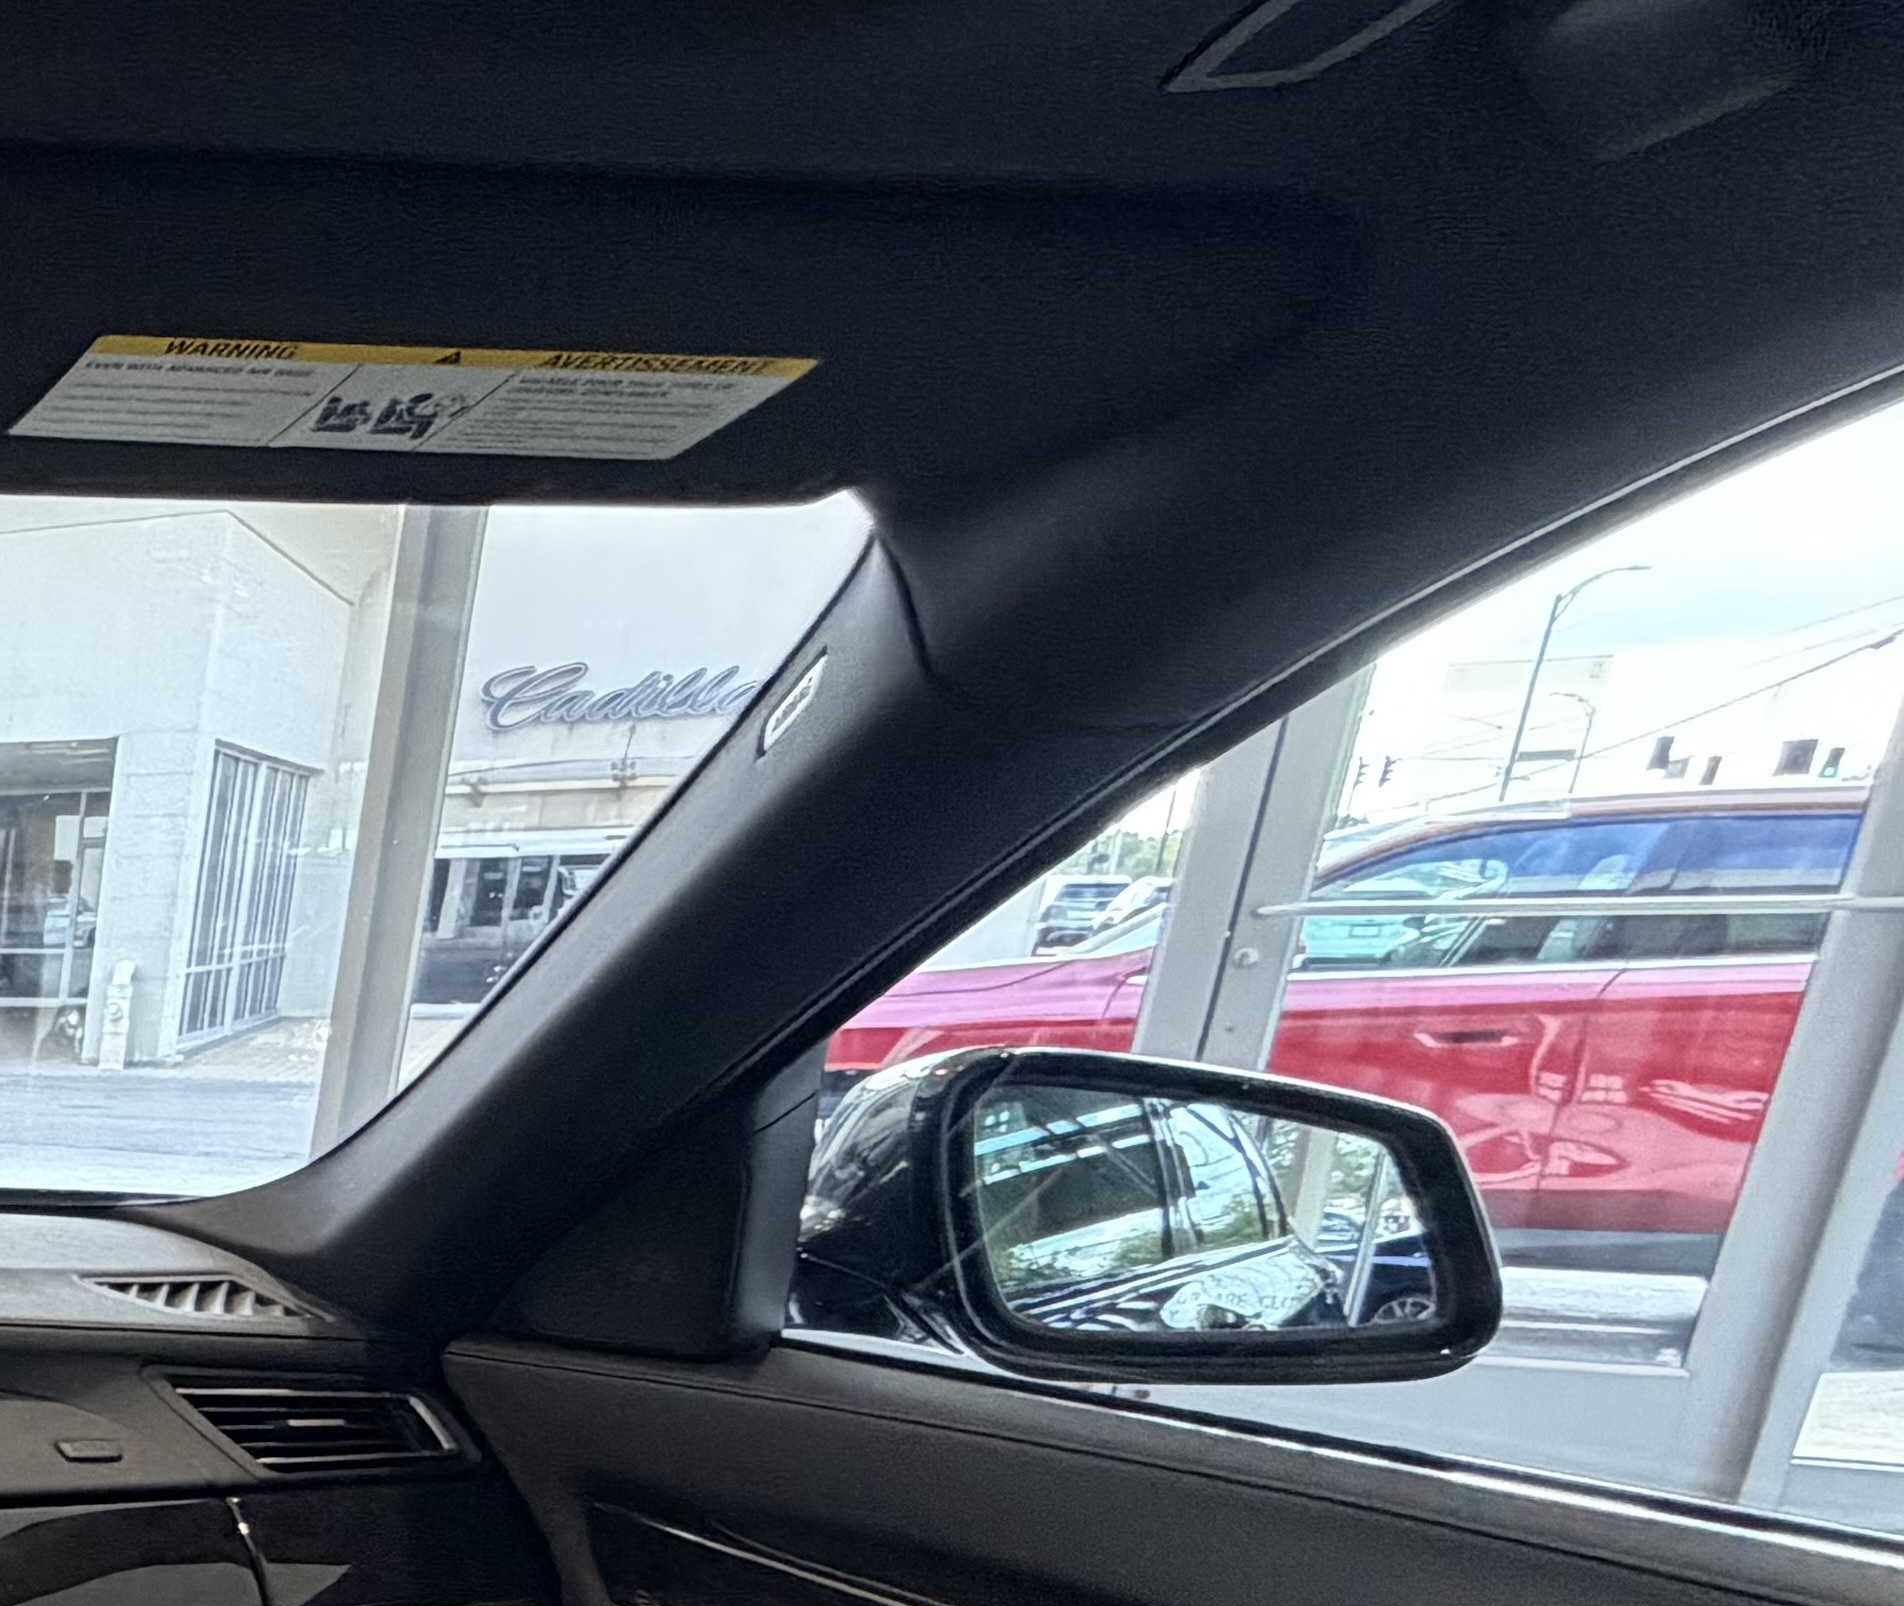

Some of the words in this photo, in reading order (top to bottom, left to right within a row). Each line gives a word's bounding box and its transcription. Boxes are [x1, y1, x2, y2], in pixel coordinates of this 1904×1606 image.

[162, 340, 298, 360] WARNING
[542, 353, 775, 374] AVERTISSEMENT
[481, 662, 763, 731] Cadilla
